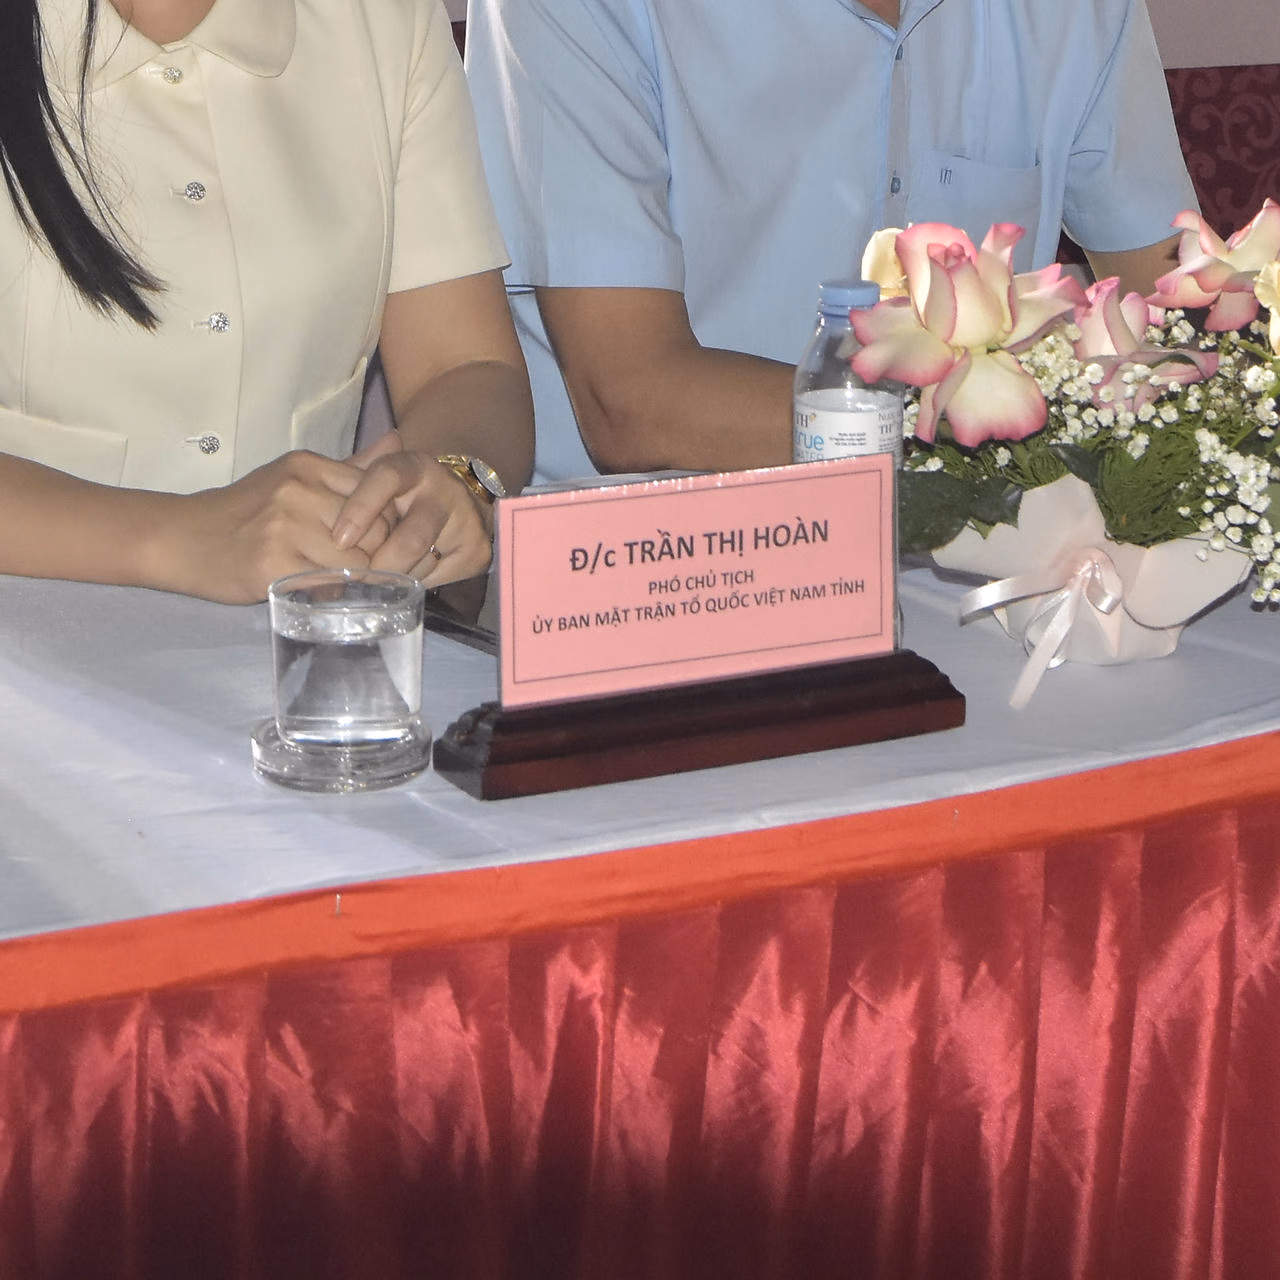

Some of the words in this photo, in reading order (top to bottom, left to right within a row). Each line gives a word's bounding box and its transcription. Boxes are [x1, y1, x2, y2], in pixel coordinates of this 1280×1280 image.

[569, 542, 616, 575] Đ/c
[624, 528, 695, 565] TRẦN
[703, 528, 744, 557] THỊ
[753, 516, 829, 551] HOÀN
[532, 614, 553, 634] ỦY
[558, 613, 590, 631] BAN
[595, 607, 630, 628] MẶT
[634, 601, 676, 622] TRẬN
[705, 590, 750, 613] QUỐC
[753, 587, 786, 607] VIỆT
[790, 584, 826, 601] NAM
[830, 577, 865, 596] TỈNH
[648, 575, 681, 595] PHÓ
[685, 569, 717, 591] CHỦ
[721, 569, 754, 589] TỊCH
